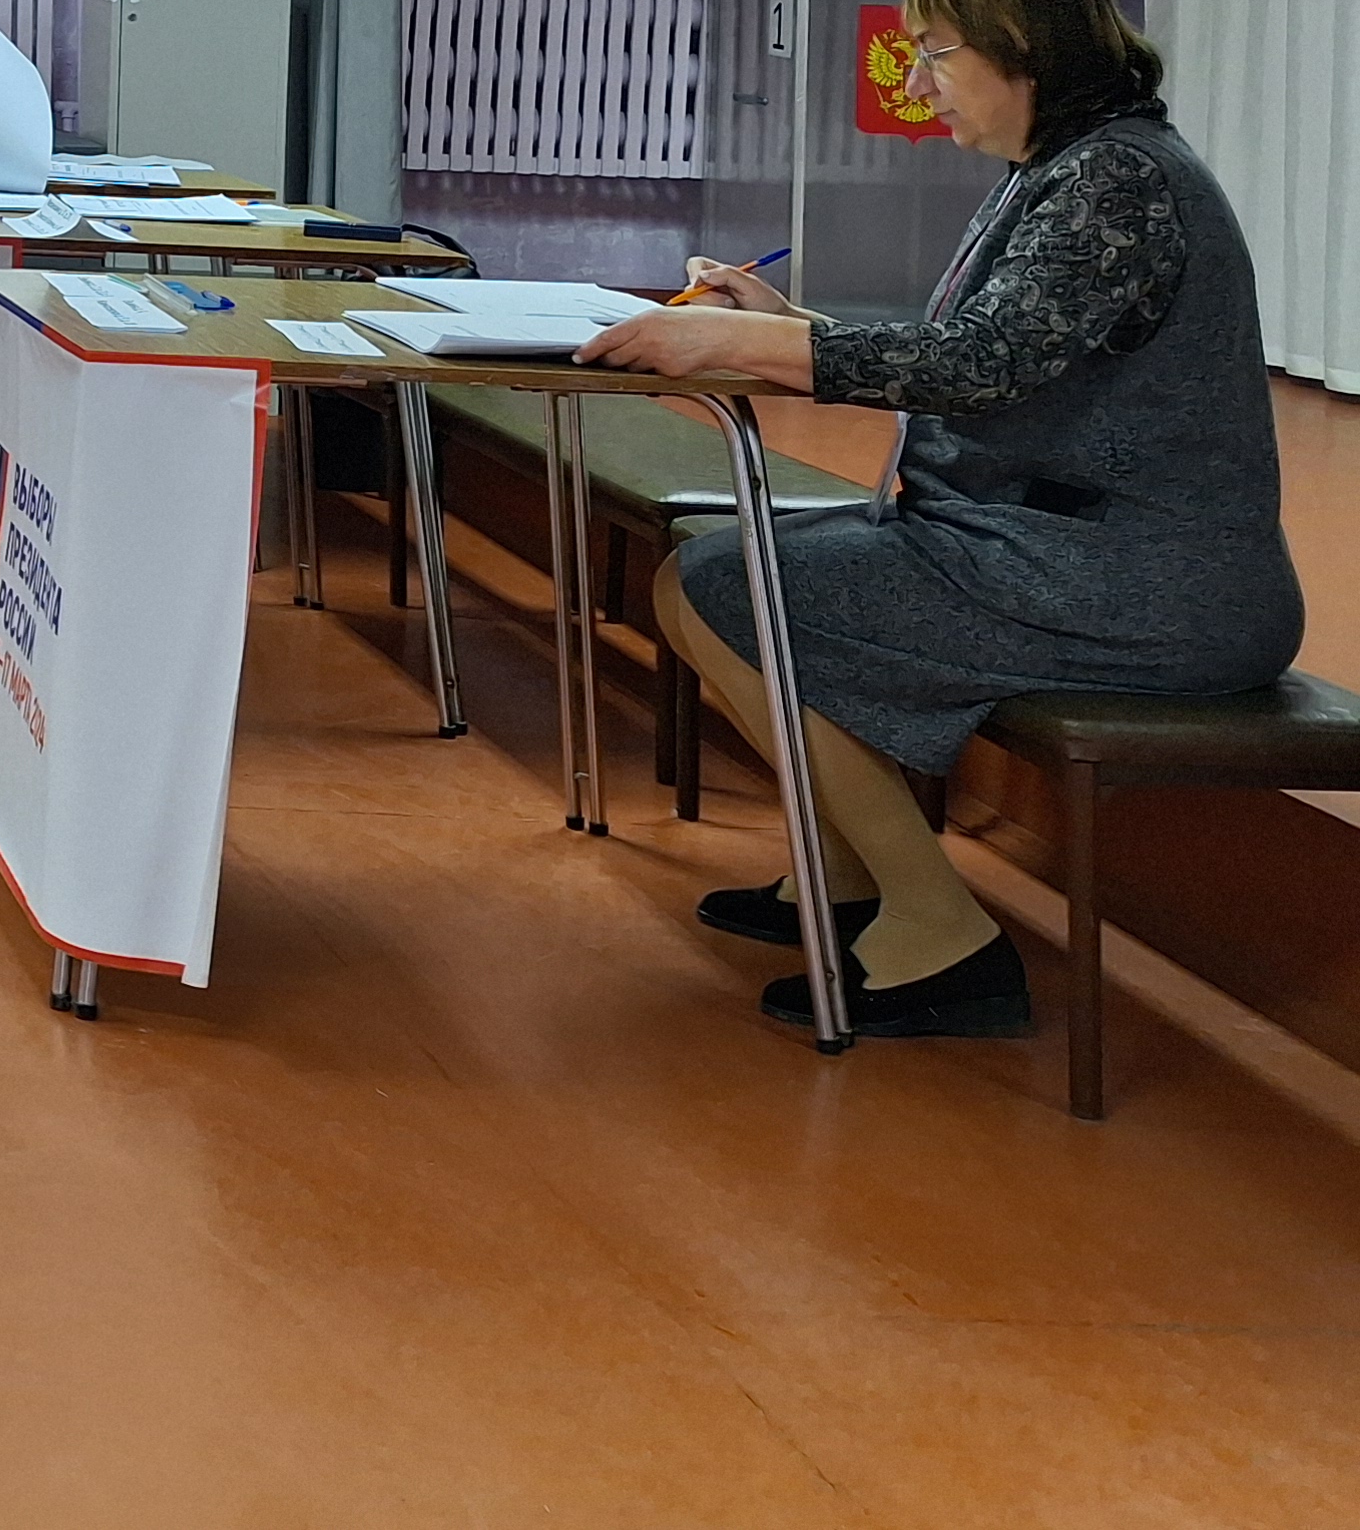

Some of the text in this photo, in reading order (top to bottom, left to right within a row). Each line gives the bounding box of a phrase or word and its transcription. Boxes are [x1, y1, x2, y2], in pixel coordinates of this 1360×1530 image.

[773, 2, 784, 50] 1
[13, 462, 57, 546] ВЫБОРЫ
[5, 521, 62, 637] ПРЕЗИДЕНТА
